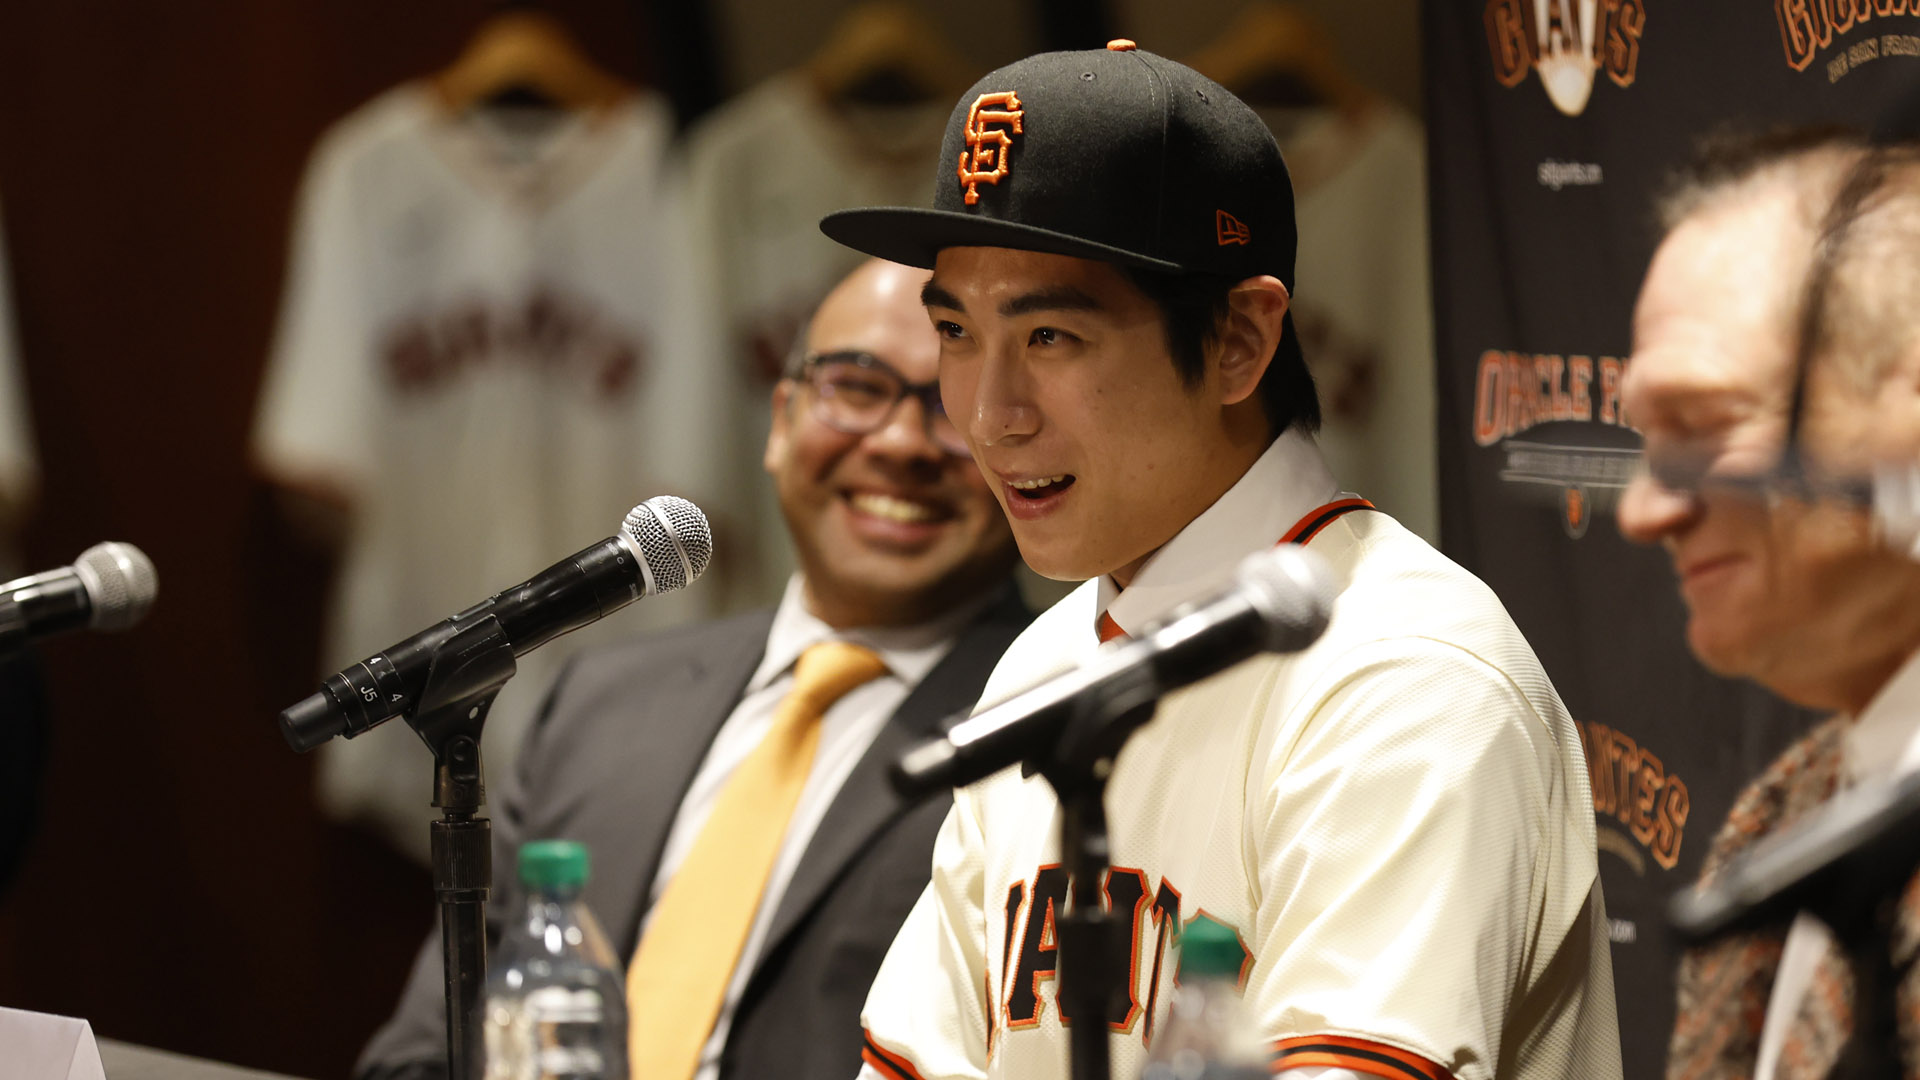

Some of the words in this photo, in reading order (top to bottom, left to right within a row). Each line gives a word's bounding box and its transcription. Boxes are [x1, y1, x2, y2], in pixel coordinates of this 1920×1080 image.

[1848, 37, 1879, 69] SAN
[959, 90, 1024, 205] SF
[1473, 350, 1593, 447] ORACLE
[360, 686, 378, 702] J5
[391, 693, 403, 702] 4
[1575, 719, 1690, 870] NTES
